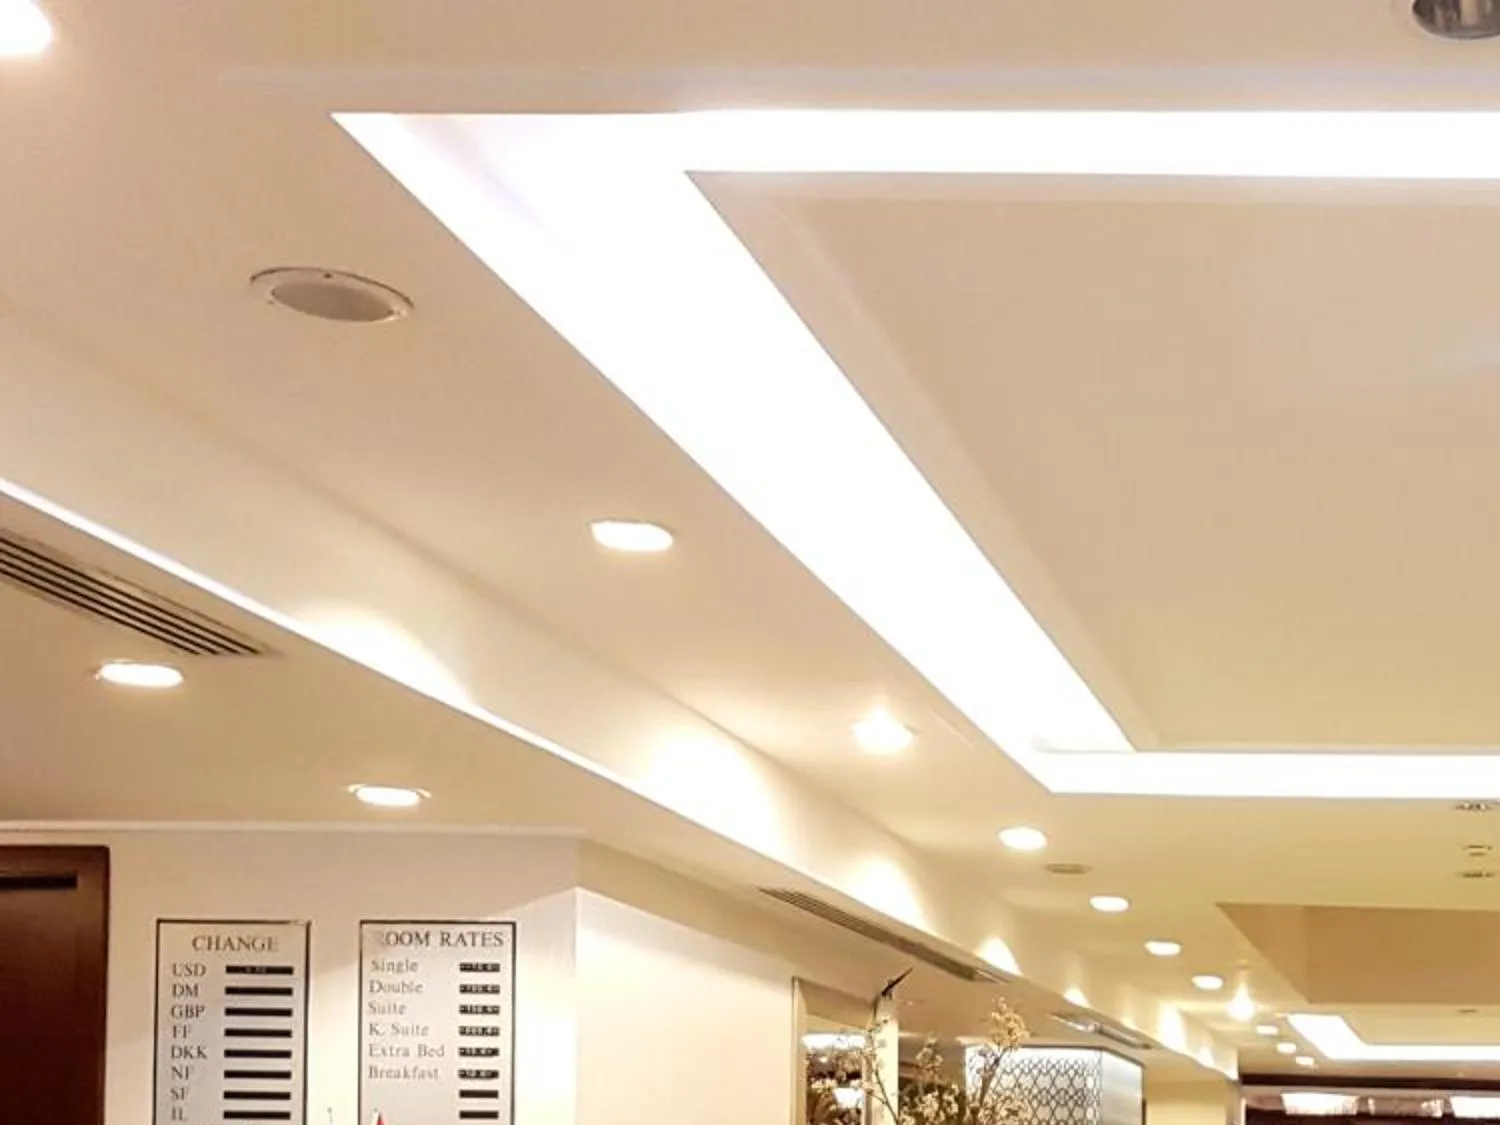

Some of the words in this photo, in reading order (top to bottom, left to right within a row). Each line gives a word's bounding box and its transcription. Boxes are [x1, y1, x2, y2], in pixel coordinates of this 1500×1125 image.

[192, 935, 280, 953] CHANGE
[374, 931, 430, 947] OOM
[439, 931, 505, 947] RATES
[171, 963, 207, 977] USD
[371, 959, 419, 974] Single
[172, 984, 199, 998] DM
[369, 979, 424, 994] Double
[171, 1005, 206, 1019] GBP
[368, 1001, 407, 1015] Suite
[390, 1023, 430, 1037] Suite
[171, 1045, 209, 1060] DKK
[369, 1044, 411, 1058] Extra
[417, 1044, 446, 1058] Bed
[368, 1064, 439, 1080] Breakfast
